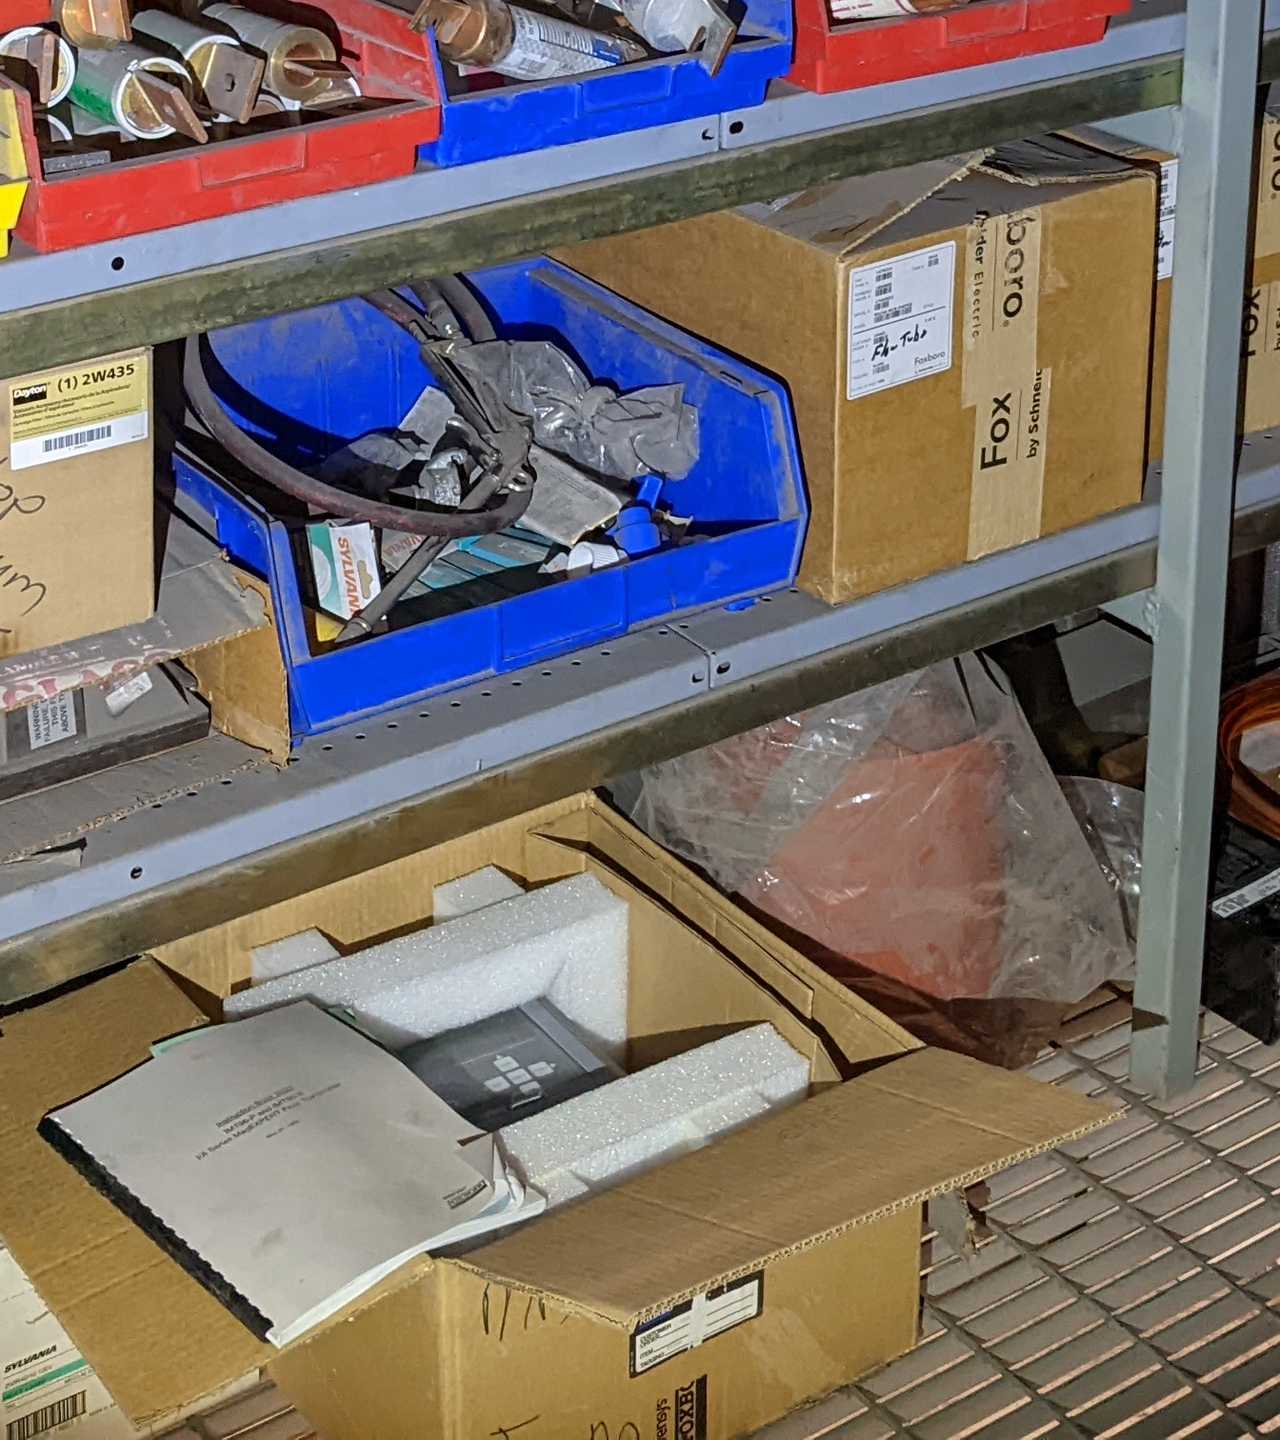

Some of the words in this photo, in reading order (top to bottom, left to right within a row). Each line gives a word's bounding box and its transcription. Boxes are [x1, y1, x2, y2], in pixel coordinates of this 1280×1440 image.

[13, 385, 47, 399] Dayton
[57, 376, 78, 393] (1)
[82, 363, 135, 386] 2W435
[980, 392, 1012, 470] Fox
[1027, 438, 1040, 458] by
[337, 536, 361, 615] SYLVAN
[4, 1344, 58, 1373] SYLVANIA
